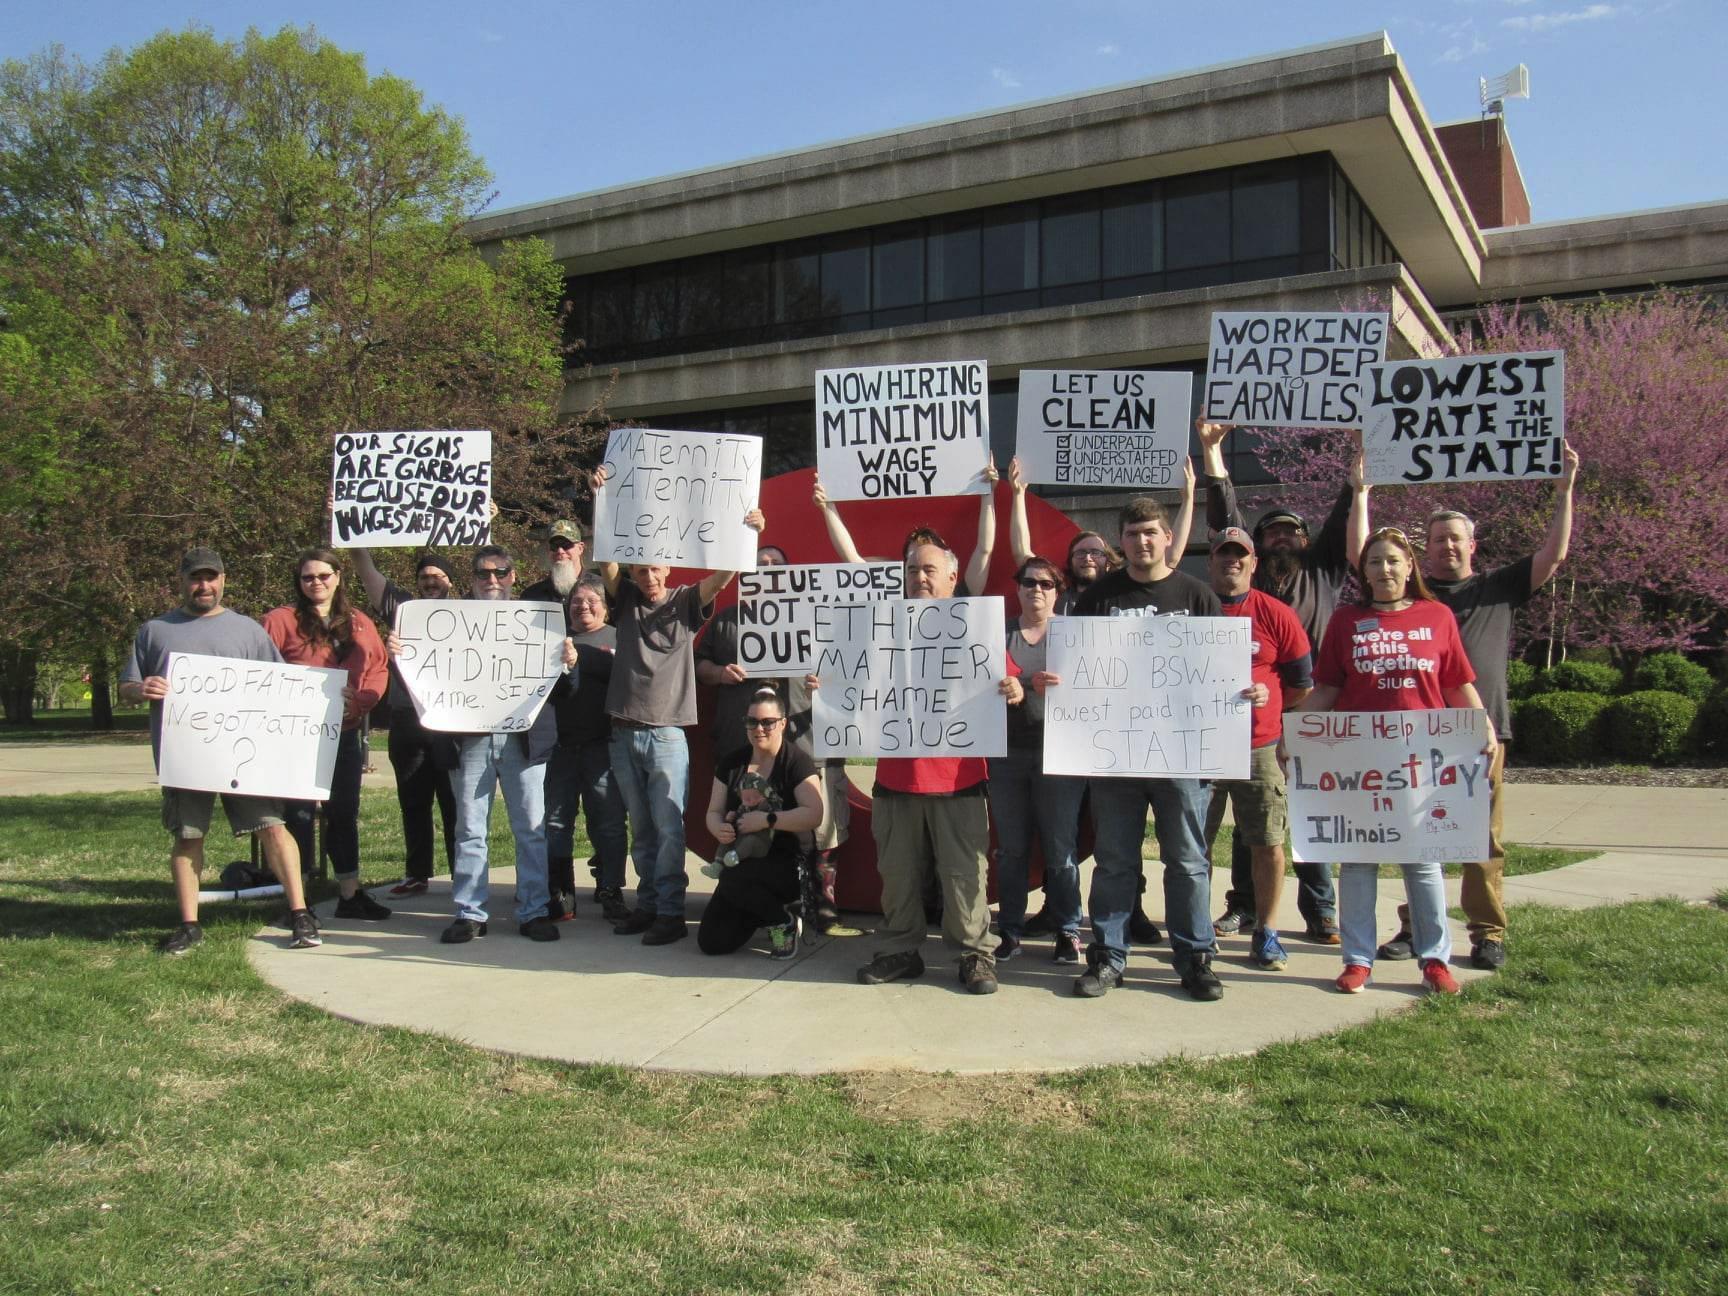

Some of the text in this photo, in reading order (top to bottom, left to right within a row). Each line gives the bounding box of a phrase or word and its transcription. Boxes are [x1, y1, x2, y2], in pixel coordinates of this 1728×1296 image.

[1218, 318, 1382, 345] WORKING
[824, 365, 982, 404] NOW HIRING
[1053, 374, 1144, 397] LET US
[1281, 376, 1304, 389] TO
[1370, 357, 1555, 406] LOWEST
[1042, 398, 1155, 429] CLEAN
[1207, 382, 1362, 423] EARN LES
[1514, 400, 1545, 416] IN
[823, 400, 982, 448] MINIMUM
[1391, 403, 1498, 441] RATE
[1506, 417, 1552, 438] THE
[336, 434, 381, 456] OUR
[1074, 450, 1177, 465] UNDERSTAFFED
[1075, 435, 1153, 450] UNDERPAID
[336, 454, 490, 486] ARE GARBAGE
[858, 446, 936, 473] WAGE
[1402, 438, 1561, 481] STATE!
[862, 471, 937, 497] ONLY
[1074, 467, 1171, 484] MISMANAGED
[335, 479, 486, 517] BECAUSE OUR
[335, 506, 490, 546] WAGES ARE TRASH
[614, 547, 684, 559] FOR ALL
[740, 566, 901, 596] SIUE DOES
[399, 605, 560, 642] LOWEST
[740, 598, 800, 625] NOT
[1050, 621, 1249, 648] Full Time Student
[1352, 628, 1432, 644] we're all
[1352, 641, 1408, 658] in this
[492, 655, 512, 681] in
[515, 643, 559, 679] IL
[816, 644, 991, 680] MATTER
[1073, 656, 1235, 688] AND BSW...
[1048, 691, 1246, 728] lowest paid in the
[825, 725, 861, 746] on
[1298, 710, 1475, 745] SIUE Help Us!!!
[231, 737, 256, 788] ?
[1093, 728, 1222, 770] STATE
[1294, 748, 1480, 797] Lowest Pay
[1373, 792, 1392, 811] in
[1307, 815, 1401, 843] Illinois
